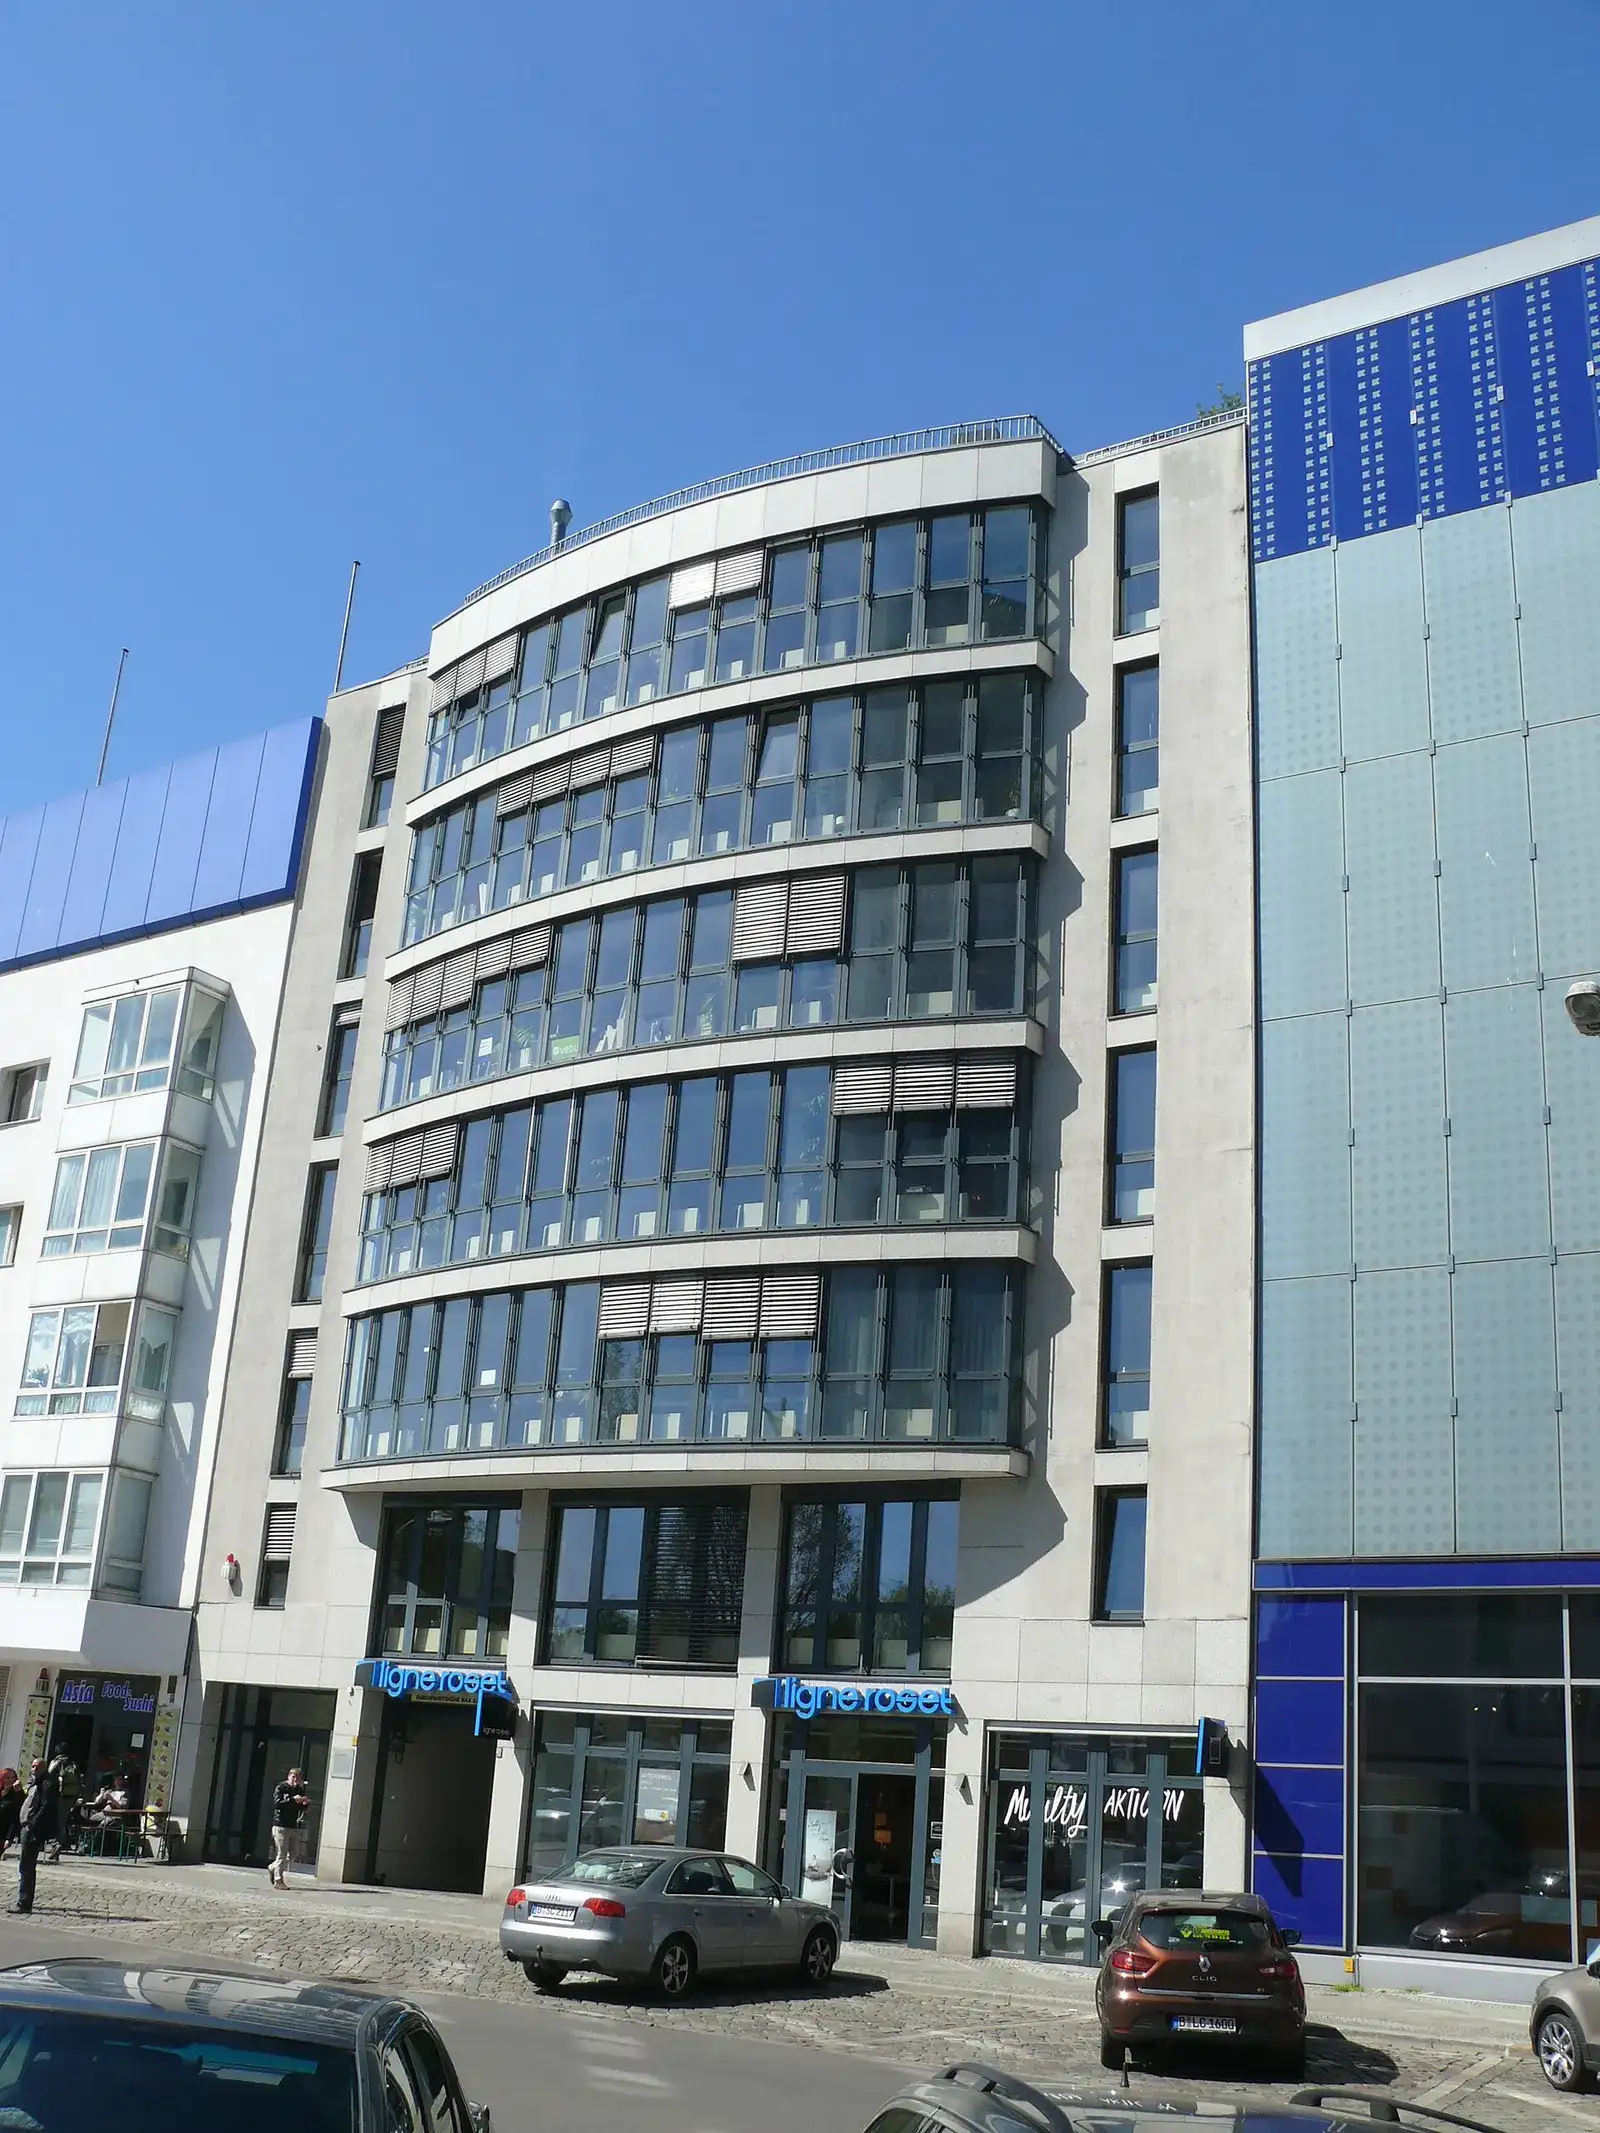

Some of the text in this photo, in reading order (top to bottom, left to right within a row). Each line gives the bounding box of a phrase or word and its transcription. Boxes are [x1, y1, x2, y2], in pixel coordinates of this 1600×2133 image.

[60, 1679, 95, 1704] Asia
[378, 1660, 508, 1697] ligne roset
[784, 1676, 953, 1720] ligne roset
